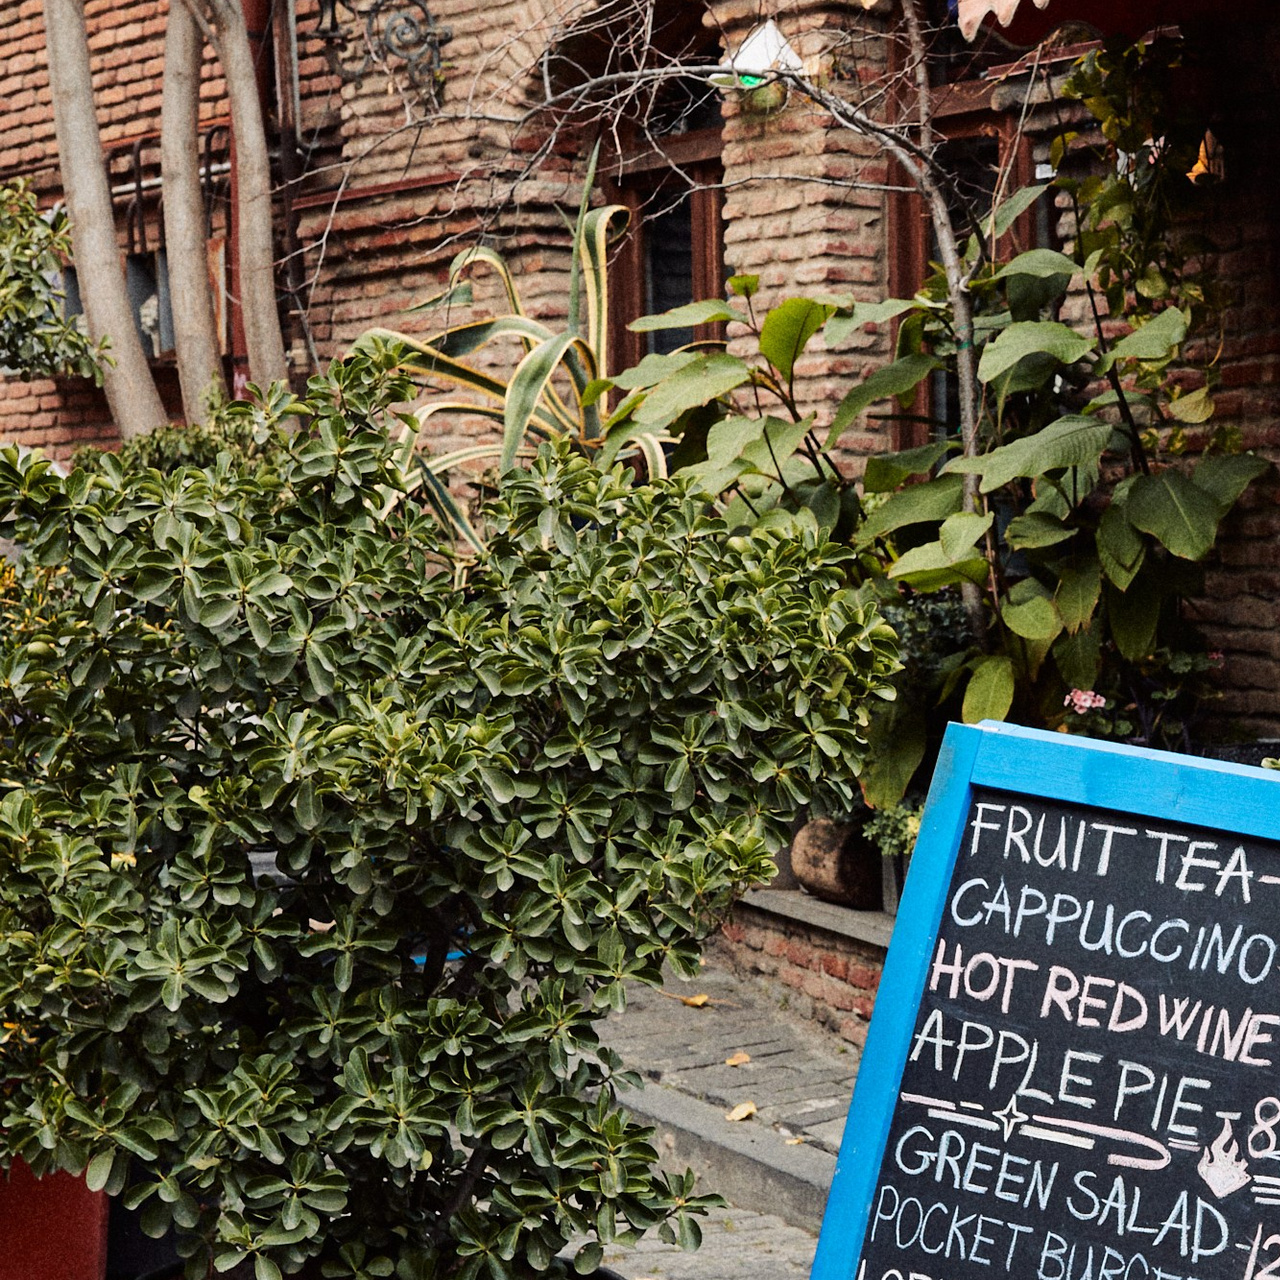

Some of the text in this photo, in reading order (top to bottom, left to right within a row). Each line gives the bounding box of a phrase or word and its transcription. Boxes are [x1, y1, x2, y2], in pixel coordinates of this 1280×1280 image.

[970, 802, 1136, 875] FRUIT
[929, 938, 1038, 1013] HOT
[1041, 964, 1148, 1032] RED
[909, 1009, 1103, 1107] APPLE
[895, 1126, 1058, 1210] GREEN
[871, 1185, 1033, 1271] POCKET
